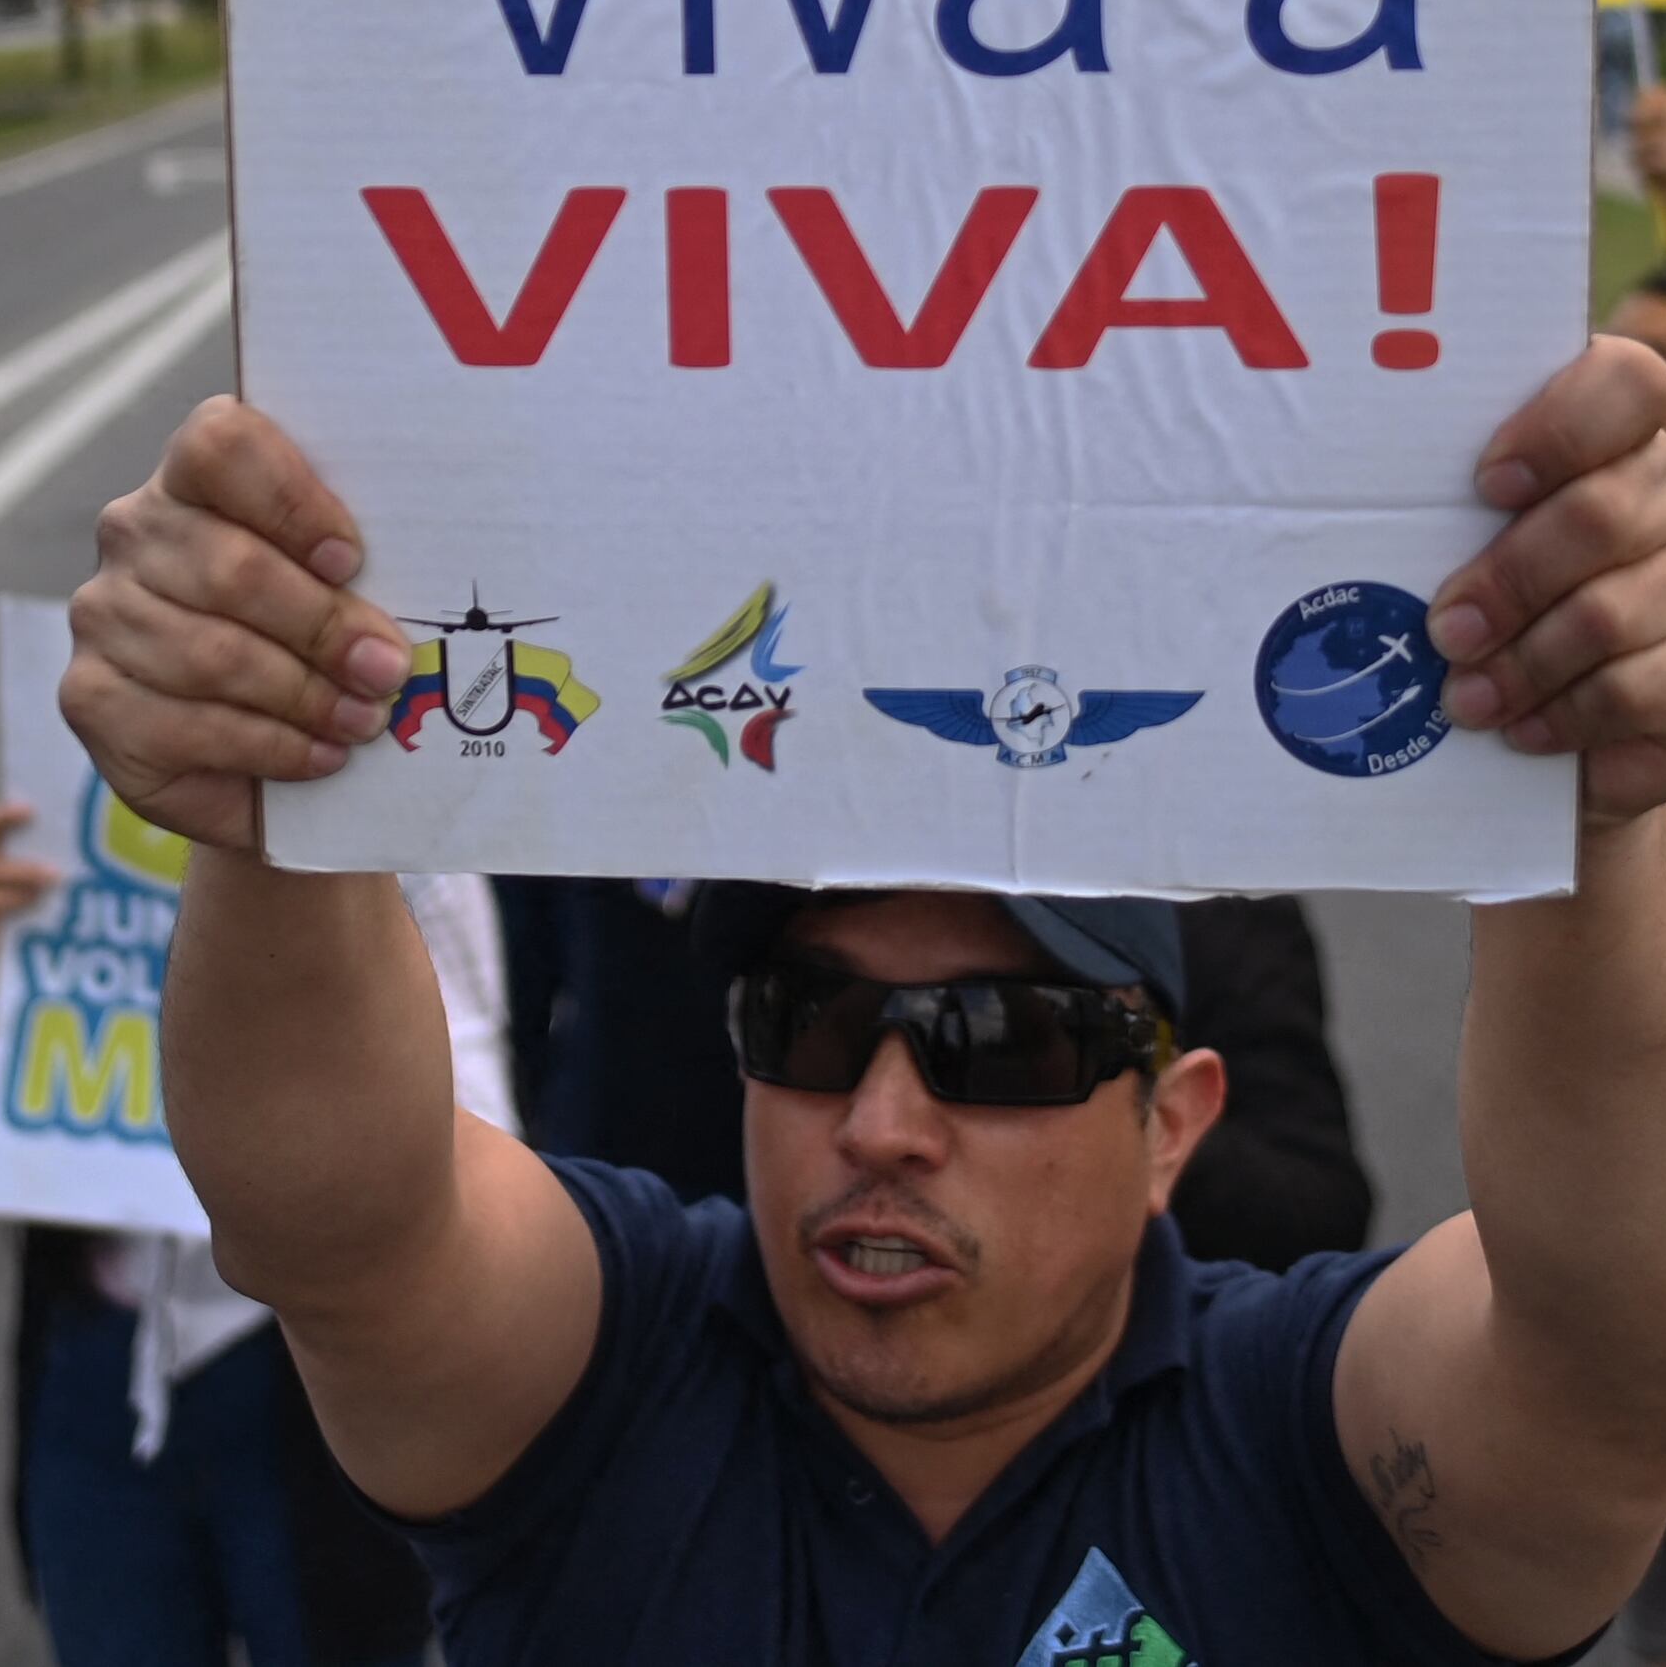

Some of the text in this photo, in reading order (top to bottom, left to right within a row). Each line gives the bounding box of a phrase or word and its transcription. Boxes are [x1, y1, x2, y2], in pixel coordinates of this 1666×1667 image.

[359, 172, 1441, 370] VIVA!
[1297, 585, 1361, 621] Acdac
[460, 740, 505, 757] 2010
[1367, 735, 1432, 774] Desde
